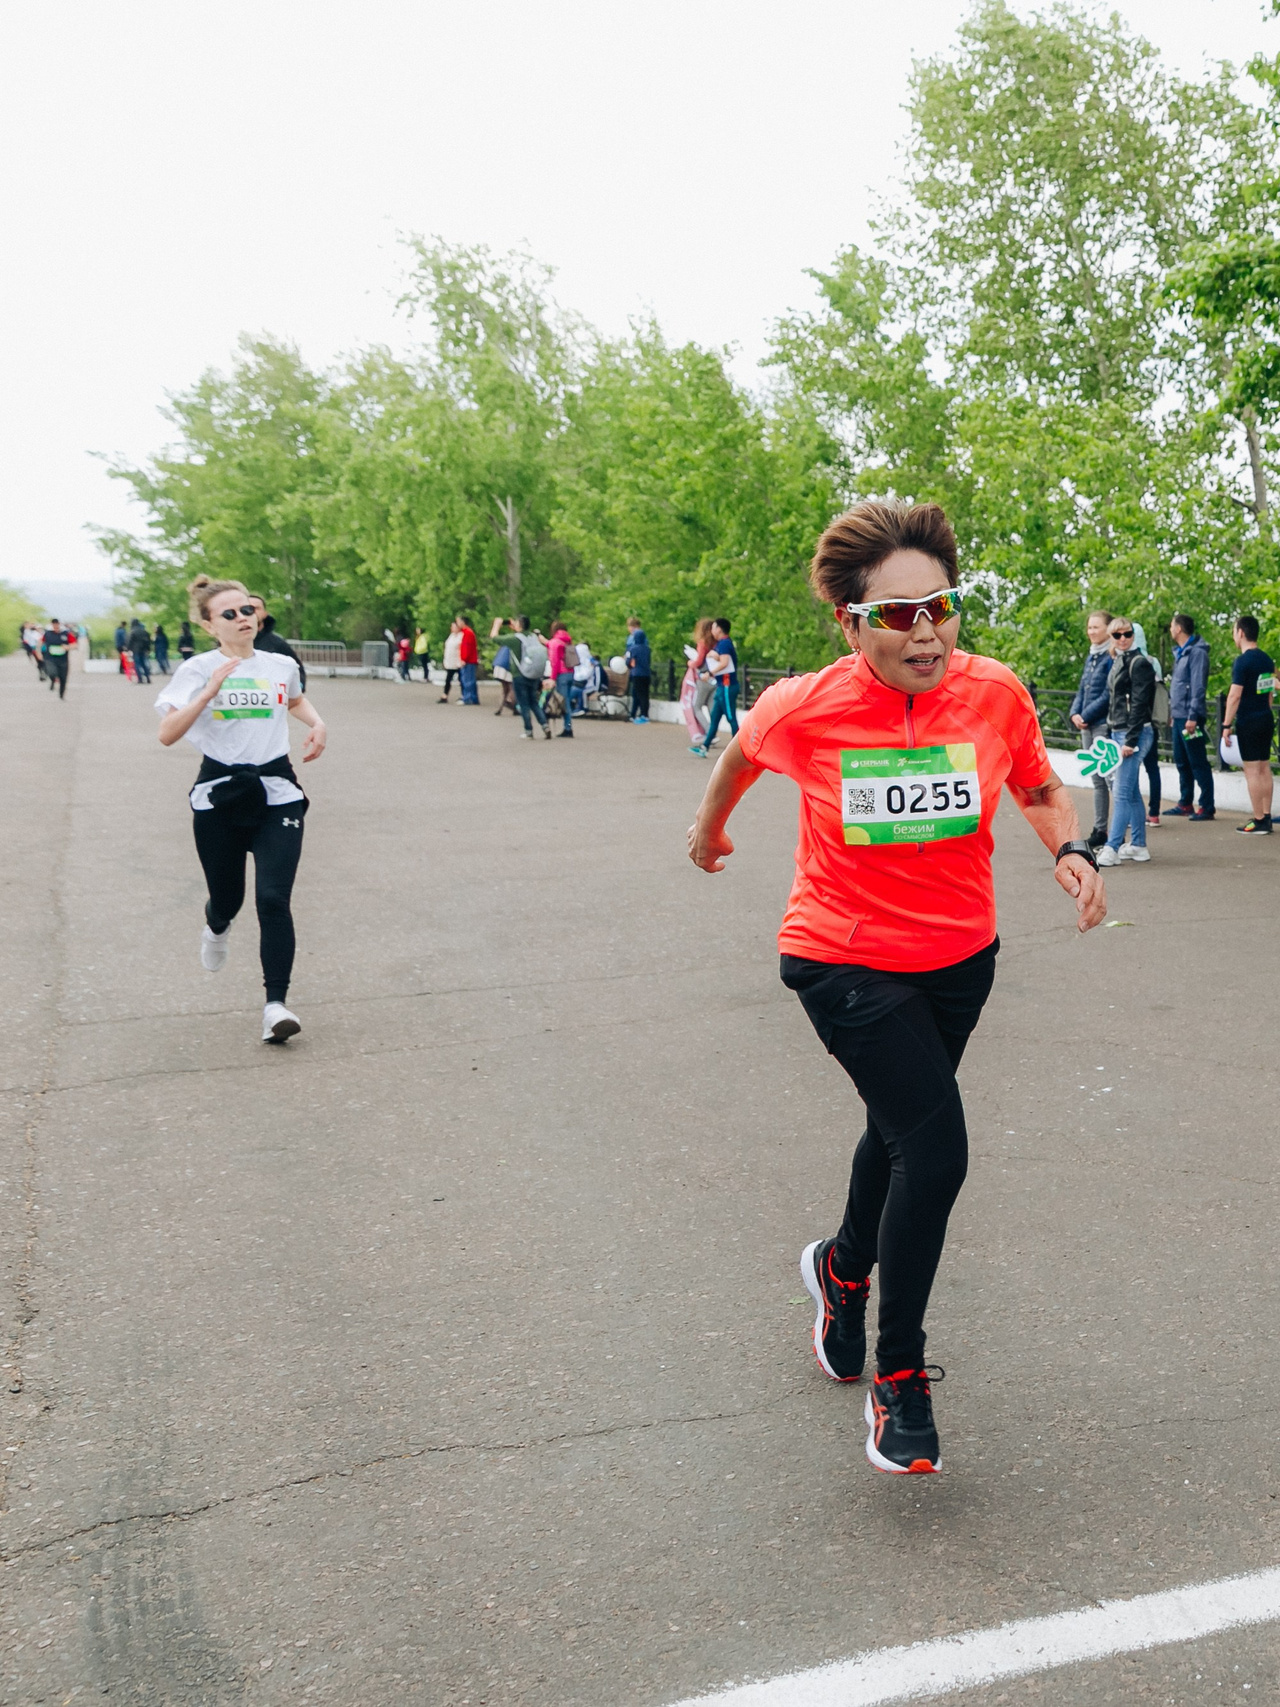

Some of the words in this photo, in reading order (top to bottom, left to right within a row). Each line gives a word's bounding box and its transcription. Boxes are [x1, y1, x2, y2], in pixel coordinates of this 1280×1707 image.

[228, 692, 270, 706] 0302
[886, 780, 972, 815] 0255
[893, 823, 935, 835] бежим
